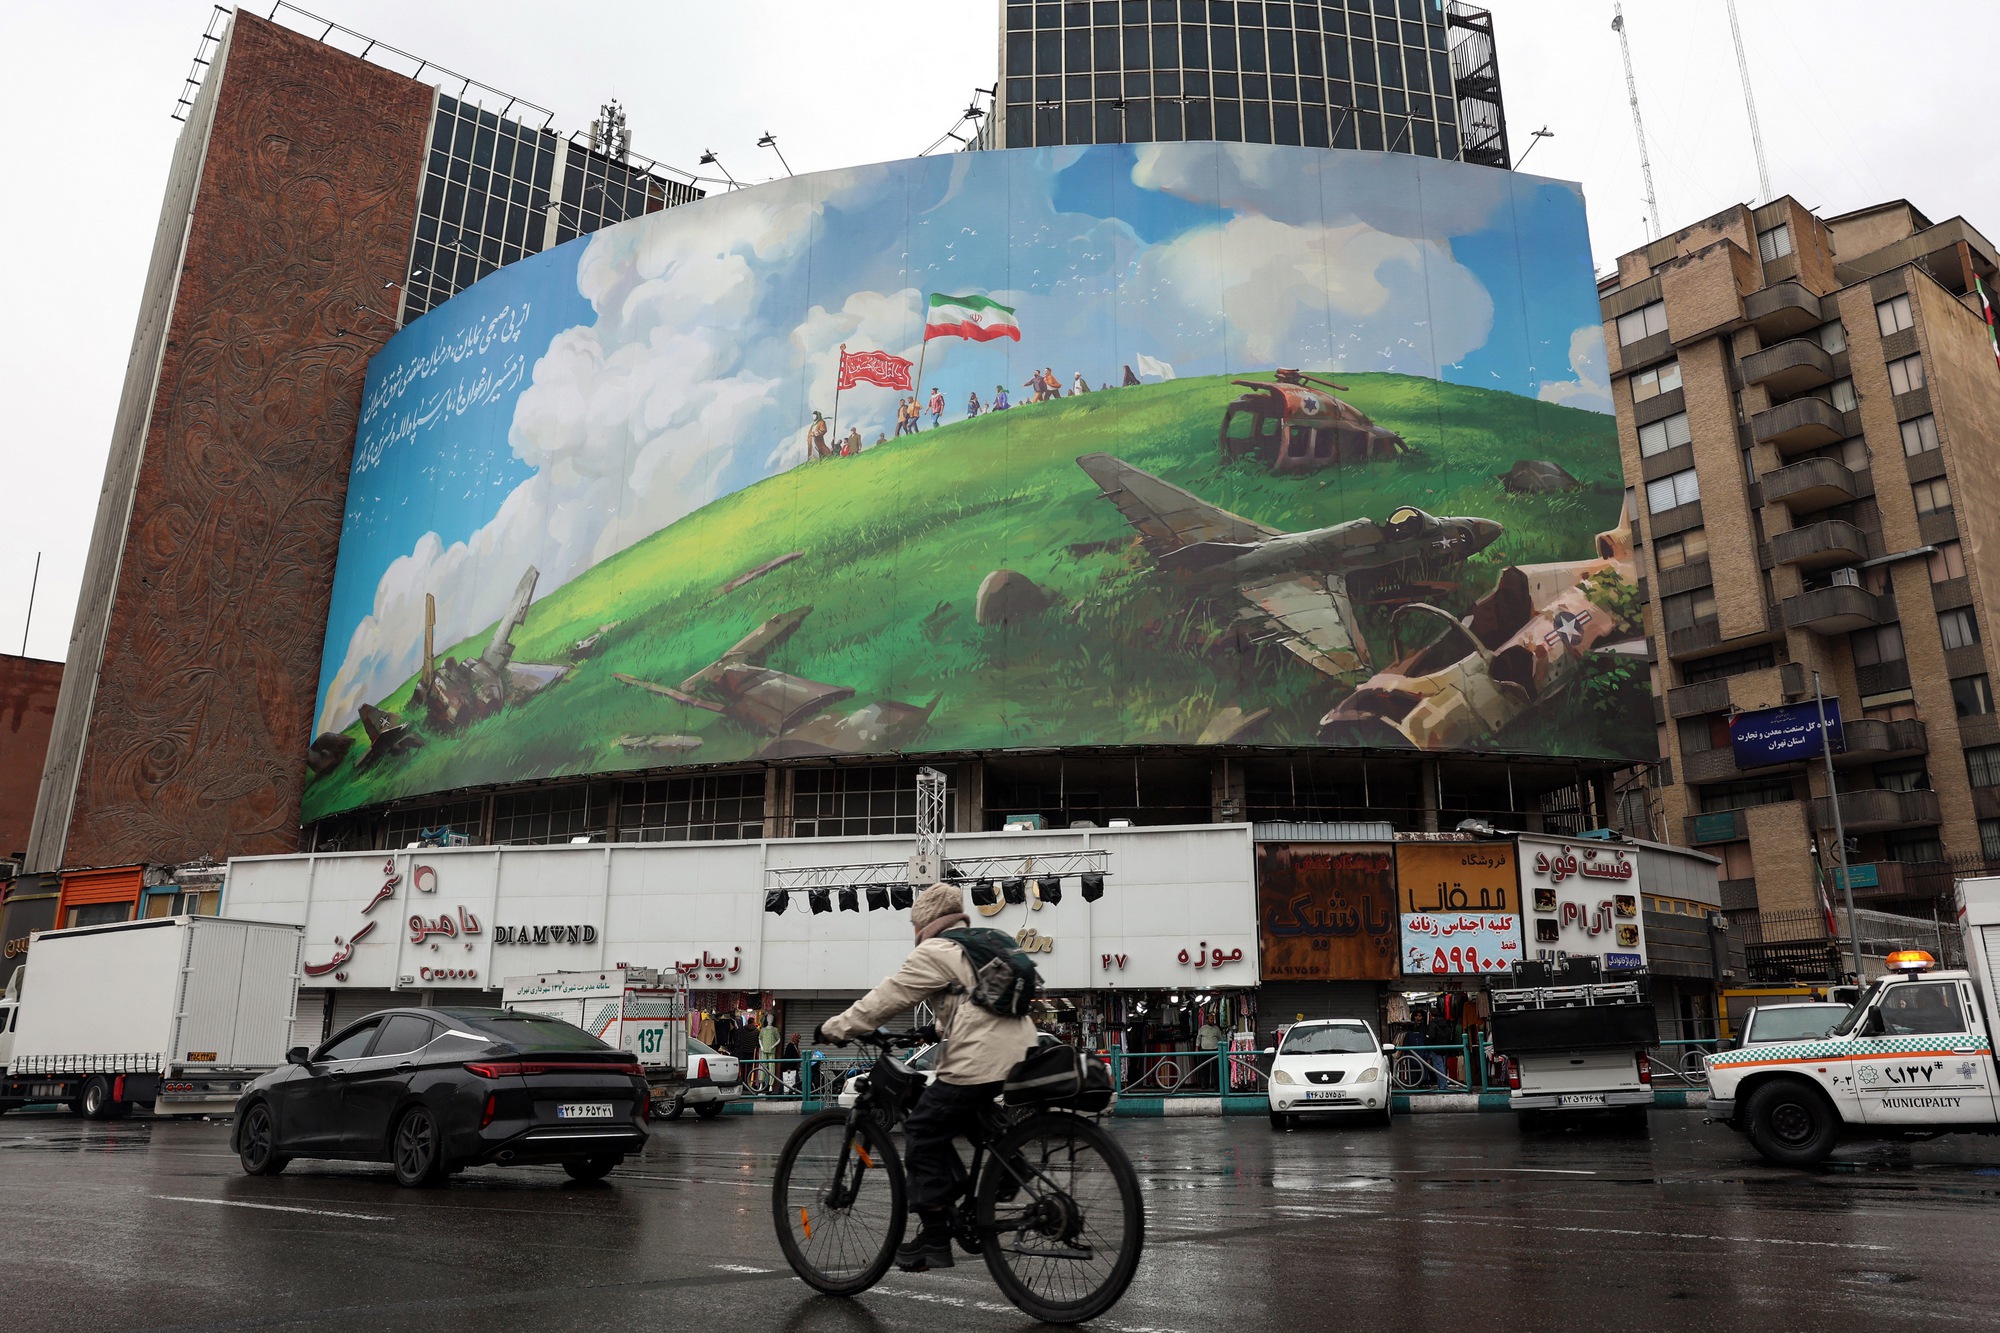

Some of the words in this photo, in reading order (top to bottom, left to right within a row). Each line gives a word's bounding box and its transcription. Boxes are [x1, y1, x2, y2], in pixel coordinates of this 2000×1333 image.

[515, 302, 531, 331] از
[508, 354, 525, 392] از
[1805, 721, 1816, 732] کل
[1816, 718, 1835, 728] اداه
[1737, 731, 1758, 743] تجارت
[1764, 728, 1782, 739] معدن
[1788, 736, 1806, 748] استان
[1768, 739, 1787, 751] تهران
[1461, 853, 1506, 868] فروشگاه
[1534, 844, 1578, 883] فود
[1579, 850, 1633, 880] فست
[1267, 890, 1393, 957] پاشیک
[1408, 916, 1439, 936] زنانه
[1442, 916, 1484, 936] اجناس
[1488, 916, 1513, 935] کلیه
[1560, 900, 1613, 936] آرام
[409, 904, 483, 951] بامبو
[1501, 940, 1517, 950] فقط
[1101, 953, 1127, 970] ۲۷
[1177, 941, 1244, 970] موزه
[1432, 946, 1518, 974] ۵۹۹۰۰
[517, 986, 530, 996] تهران
[530, 985, 551, 995] شهرداری
[577, 984, 595, 993] مدیریت
[596, 982, 610, 991] سامانه
[638, 1029, 664, 1054] 137
